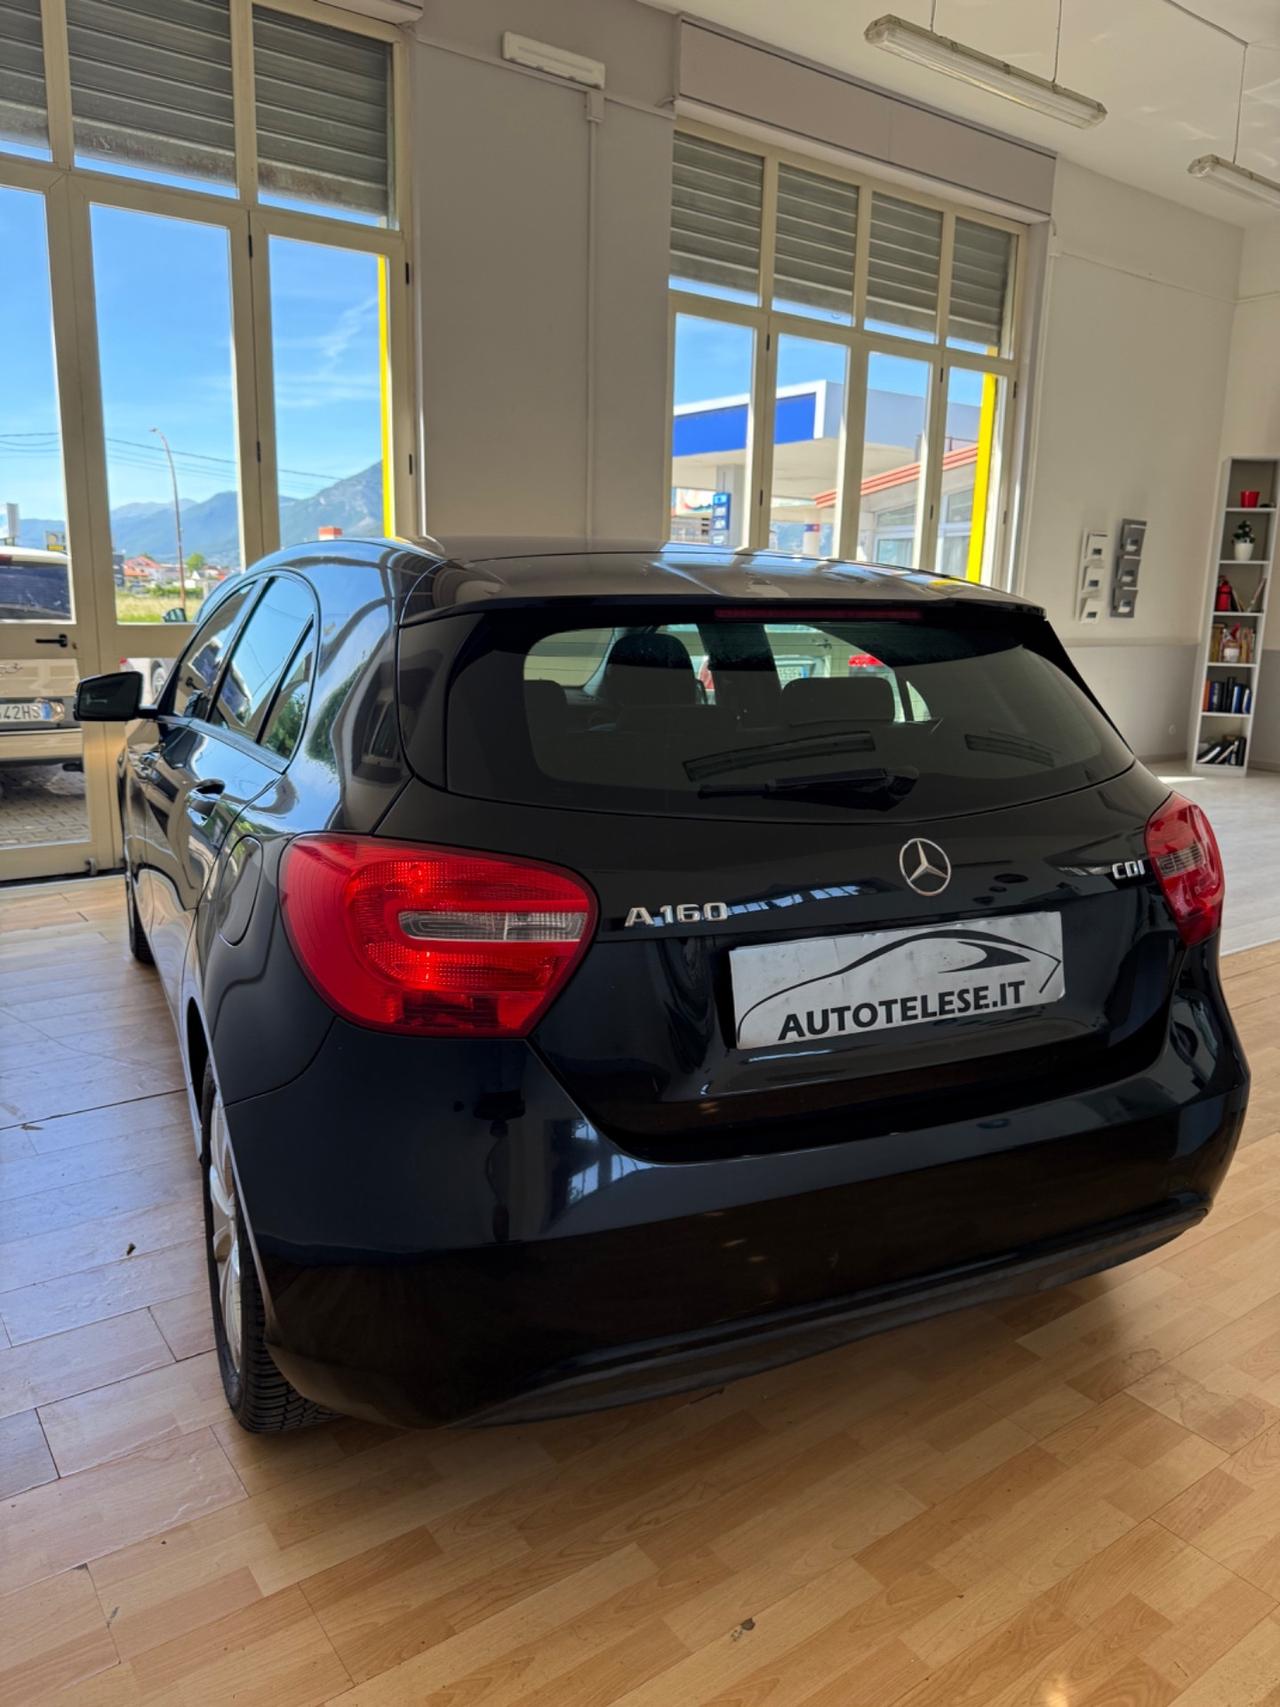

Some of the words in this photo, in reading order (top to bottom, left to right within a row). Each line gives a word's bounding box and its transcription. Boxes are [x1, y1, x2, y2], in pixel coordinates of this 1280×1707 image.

[0, 704, 41, 720] 42HS
[1112, 859, 1145, 880] CDI
[778, 980, 1026, 1041] AUTOTELESE.IT
